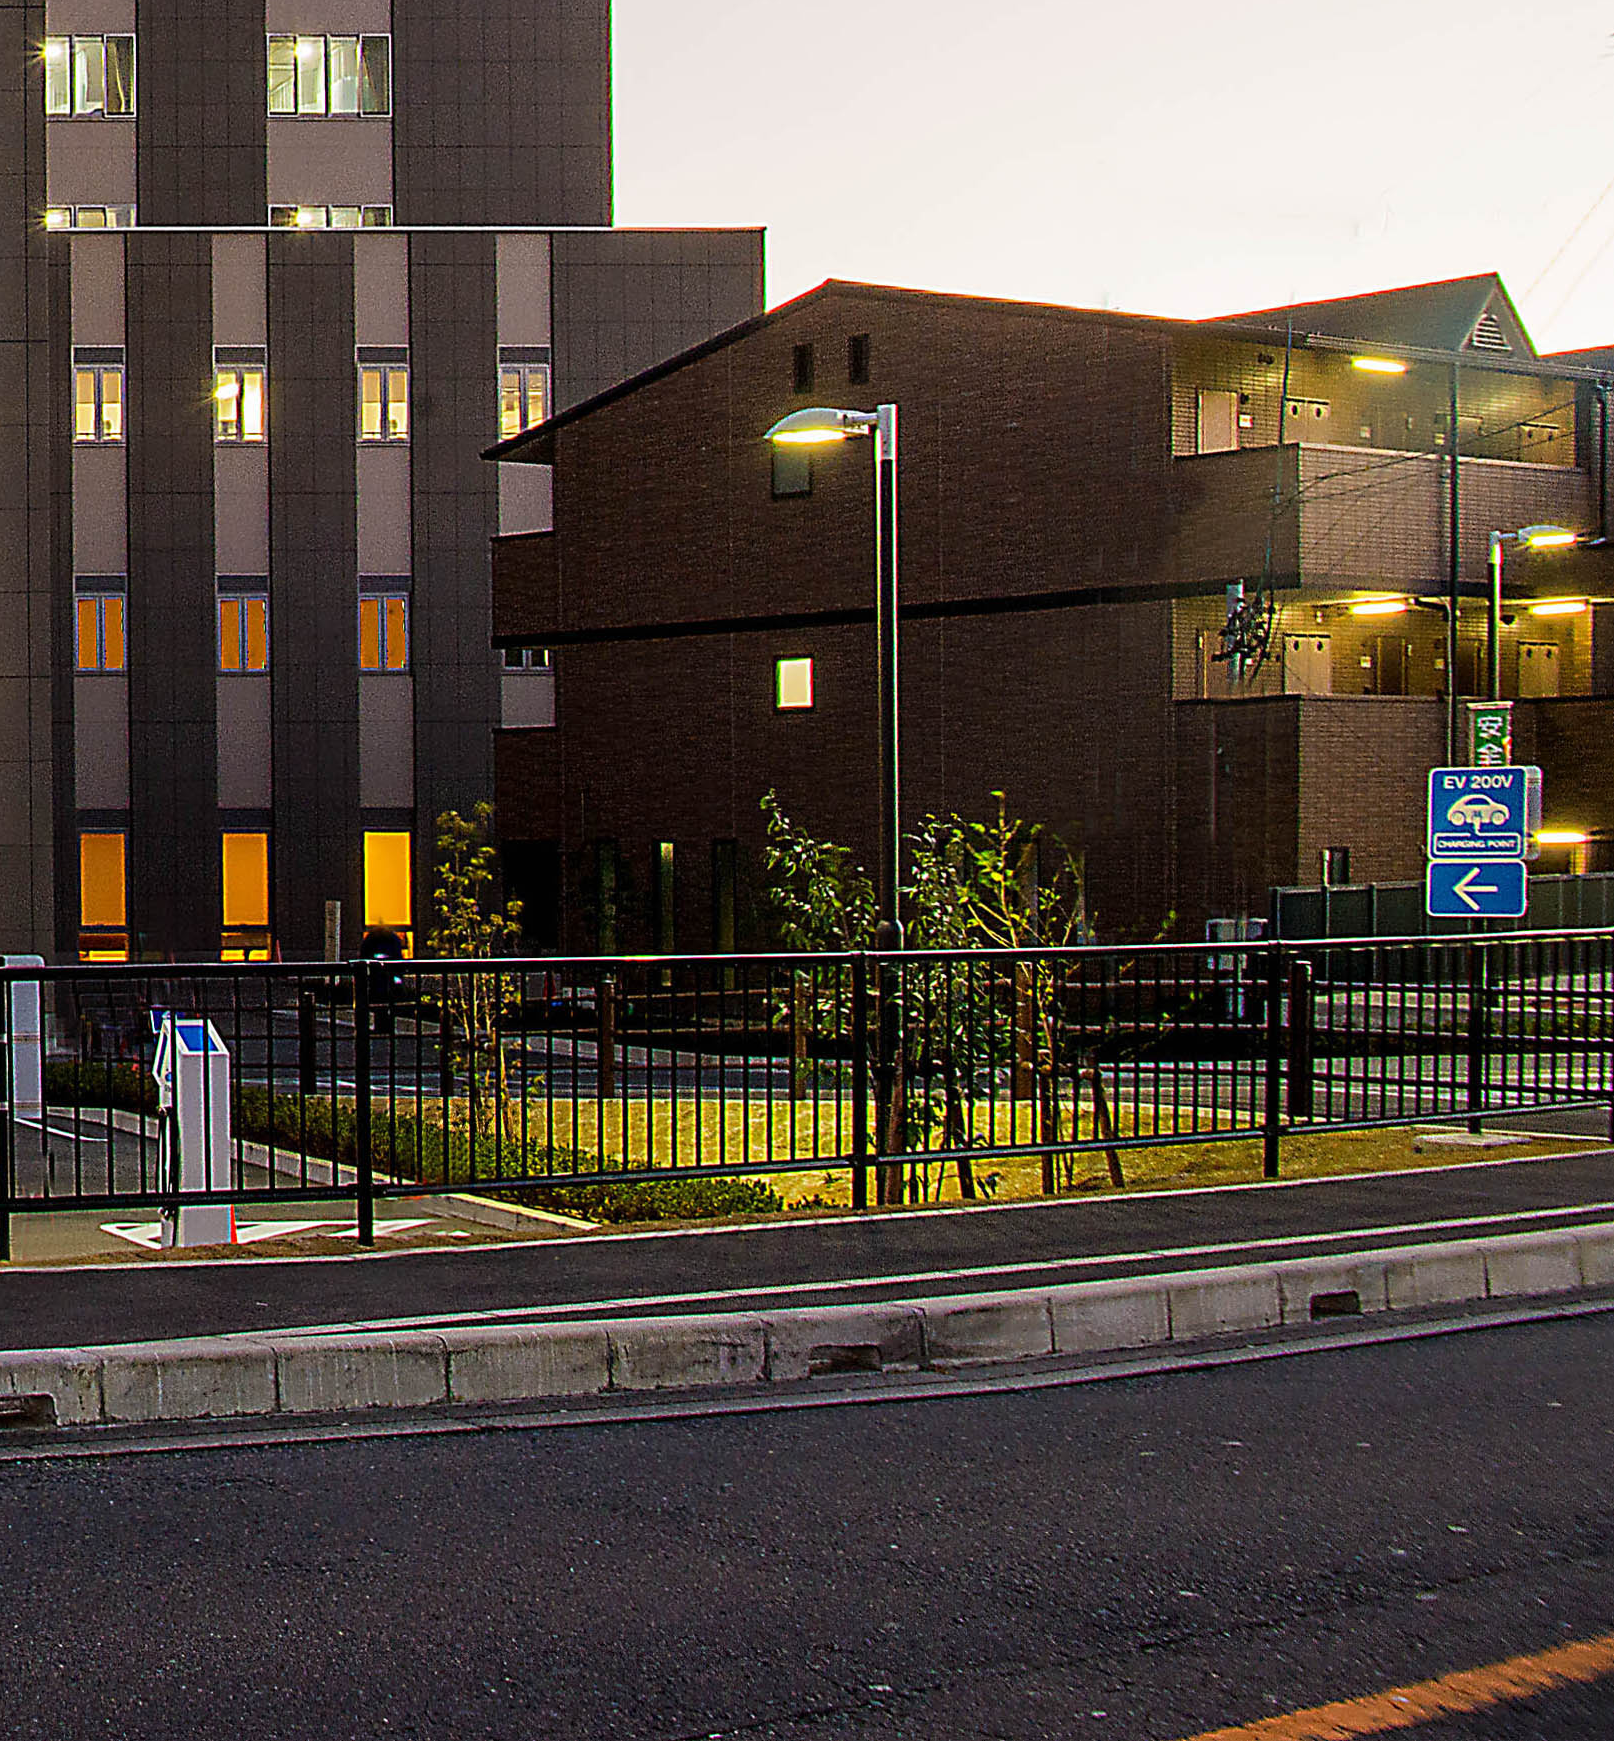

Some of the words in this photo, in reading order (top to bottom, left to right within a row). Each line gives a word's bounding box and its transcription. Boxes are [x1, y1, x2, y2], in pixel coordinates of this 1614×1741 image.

[1443, 775, 1467, 789] EV
[1471, 775, 1513, 789] 200V
[1437, 840, 1486, 848] CHARGING
[1488, 840, 1516, 848] POINT
